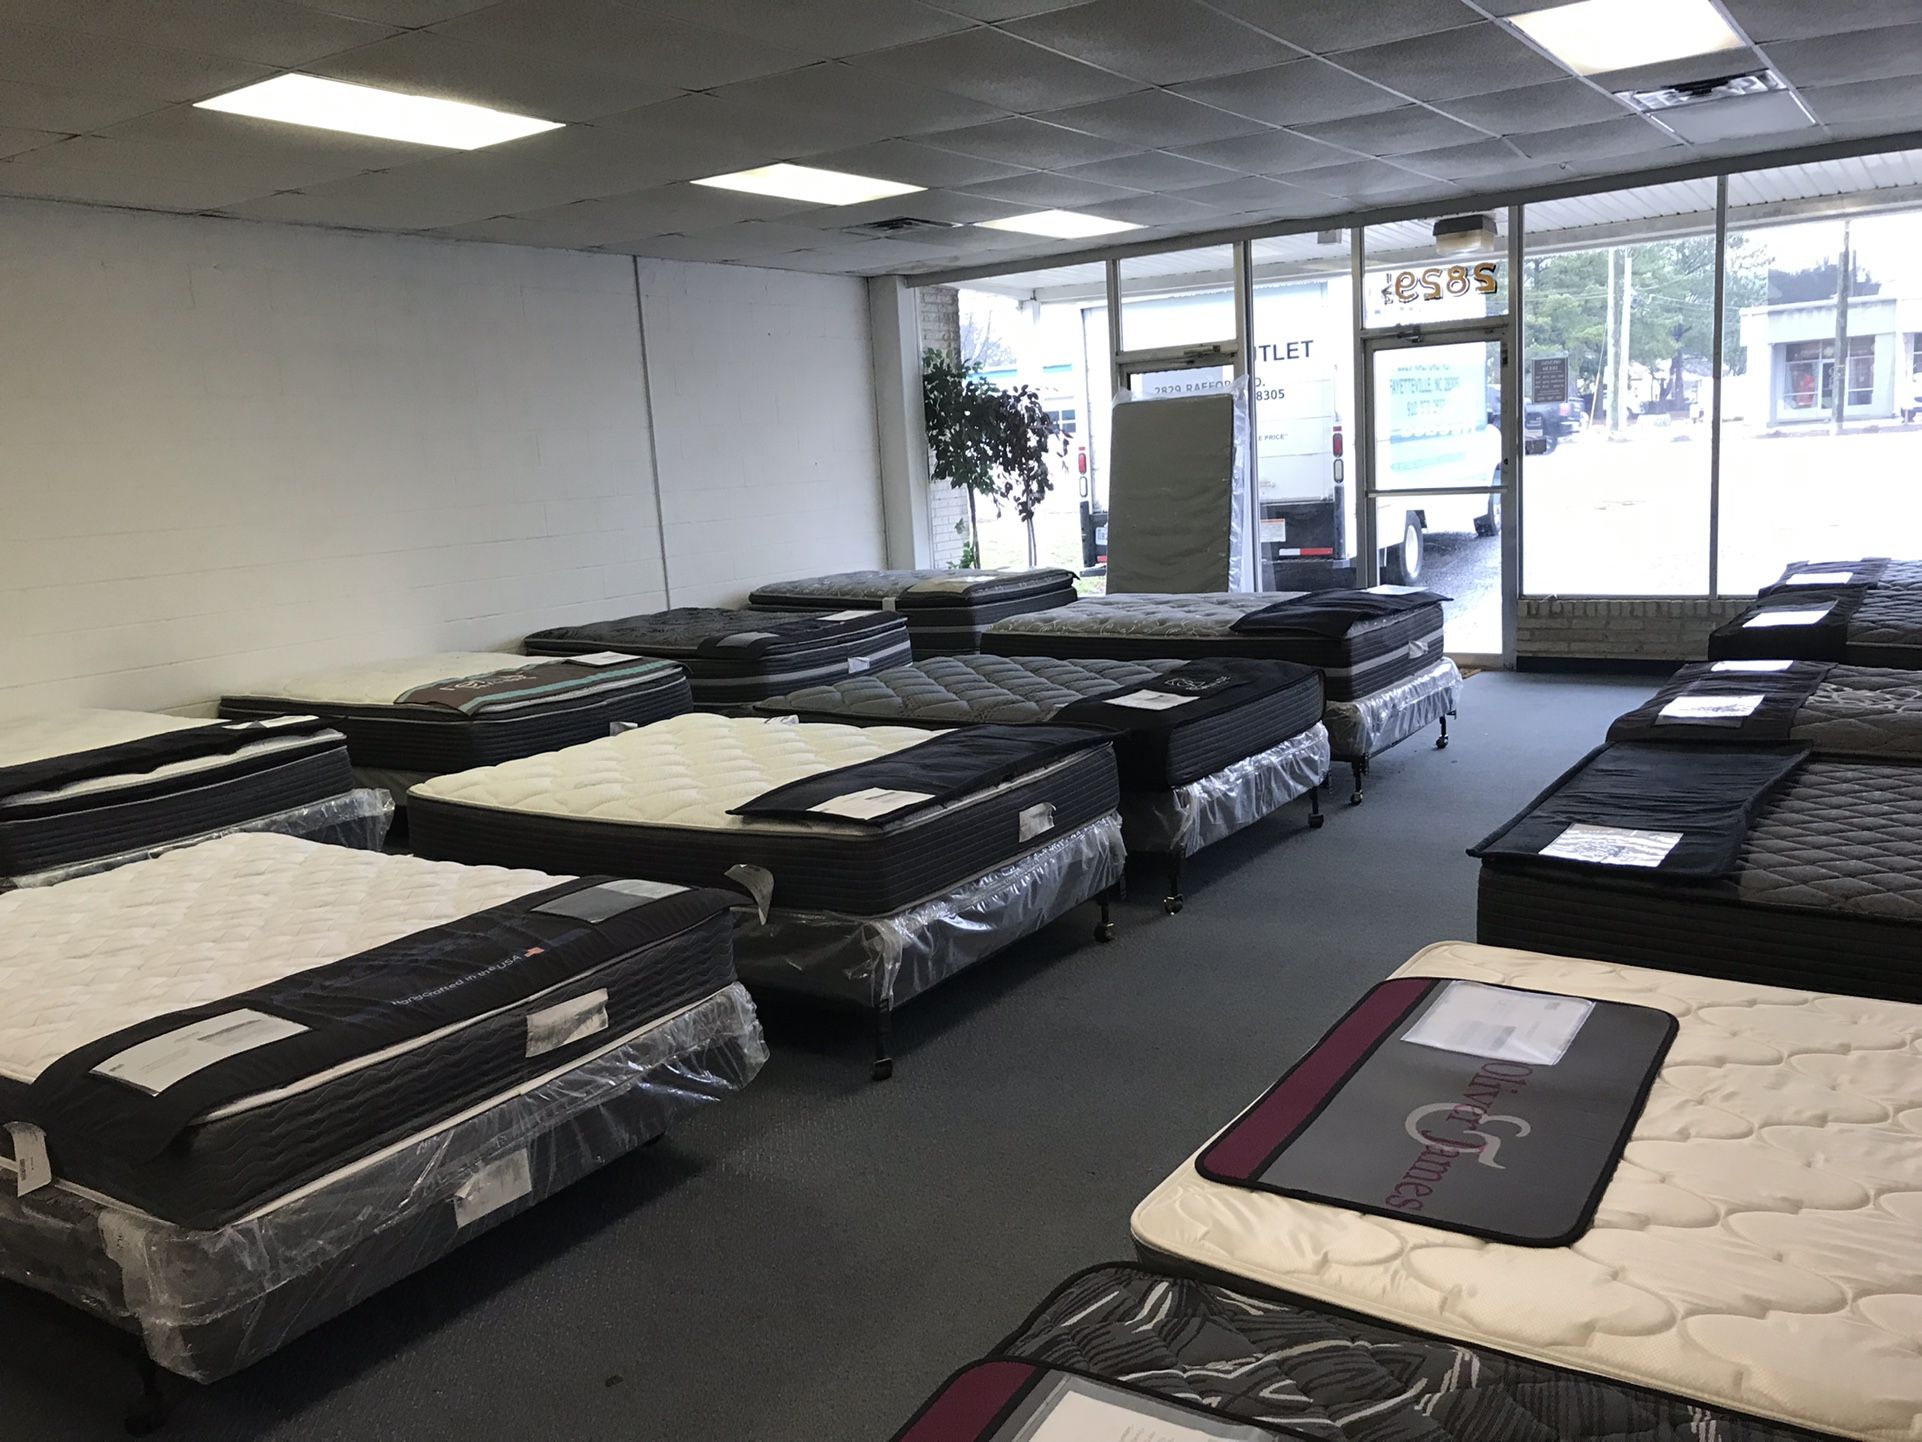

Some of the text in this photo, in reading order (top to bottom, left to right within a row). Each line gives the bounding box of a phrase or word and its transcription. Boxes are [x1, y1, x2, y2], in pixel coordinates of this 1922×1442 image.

[1254, 340, 1314, 363] TLET
[1256, 389, 1285, 401] 8305
[465, 974, 477, 983] in
[477, 966, 496, 978] the
[496, 953, 523, 970] USA
[1446, 1061, 1533, 1131] Oliver
[1384, 1129, 1488, 1212] James
